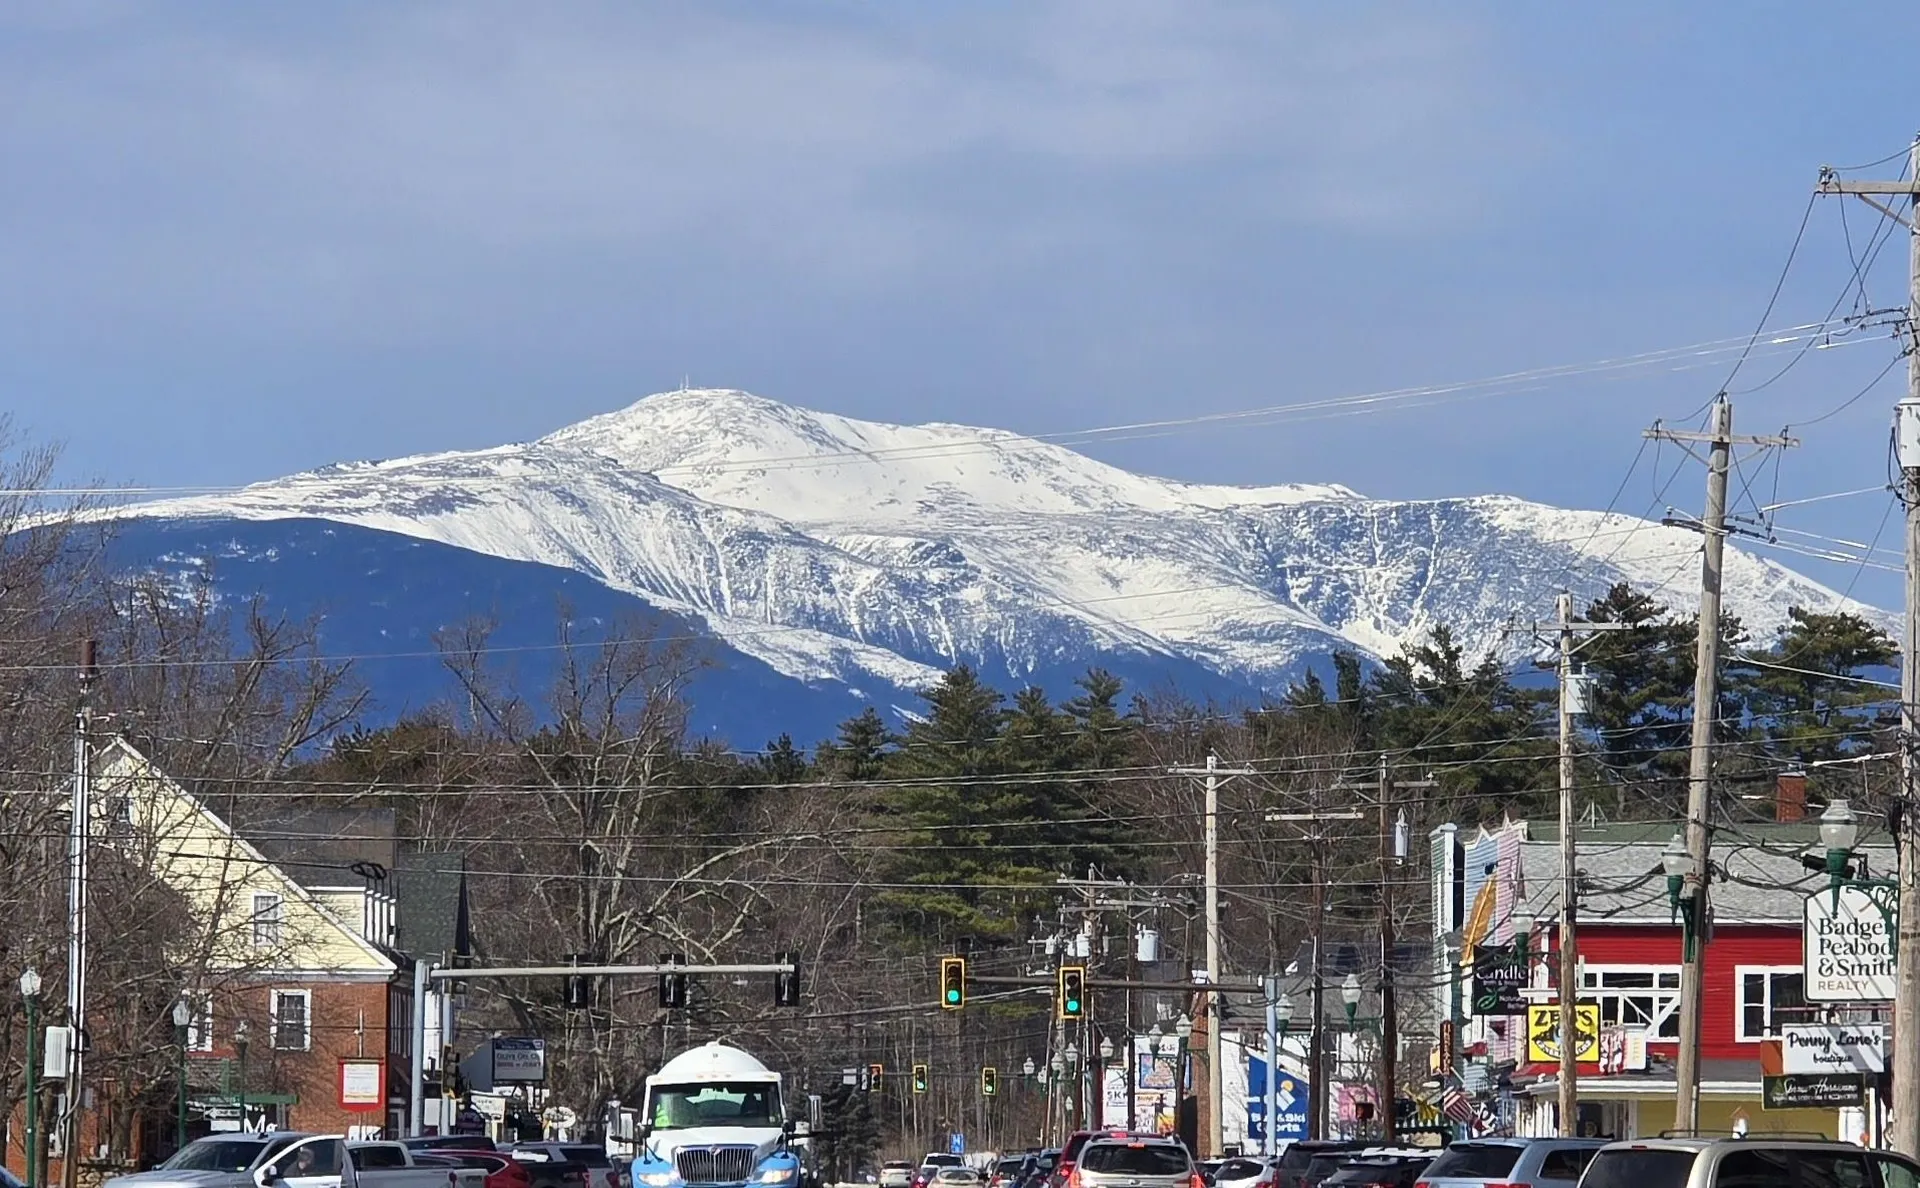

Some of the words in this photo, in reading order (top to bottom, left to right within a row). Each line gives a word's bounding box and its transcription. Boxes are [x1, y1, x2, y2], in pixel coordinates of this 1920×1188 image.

[1819, 917, 1883, 940] Badge
[1819, 938, 1890, 955] Peabo
[1818, 957, 1834, 977] &
[1818, 980, 1869, 991] REALTY
[1534, 1010, 1594, 1027] ZE'S
[1786, 1031, 1832, 1052] Penny
[1836, 1029, 1881, 1046] Lane's
[1813, 1053, 1854, 1066] boutique
